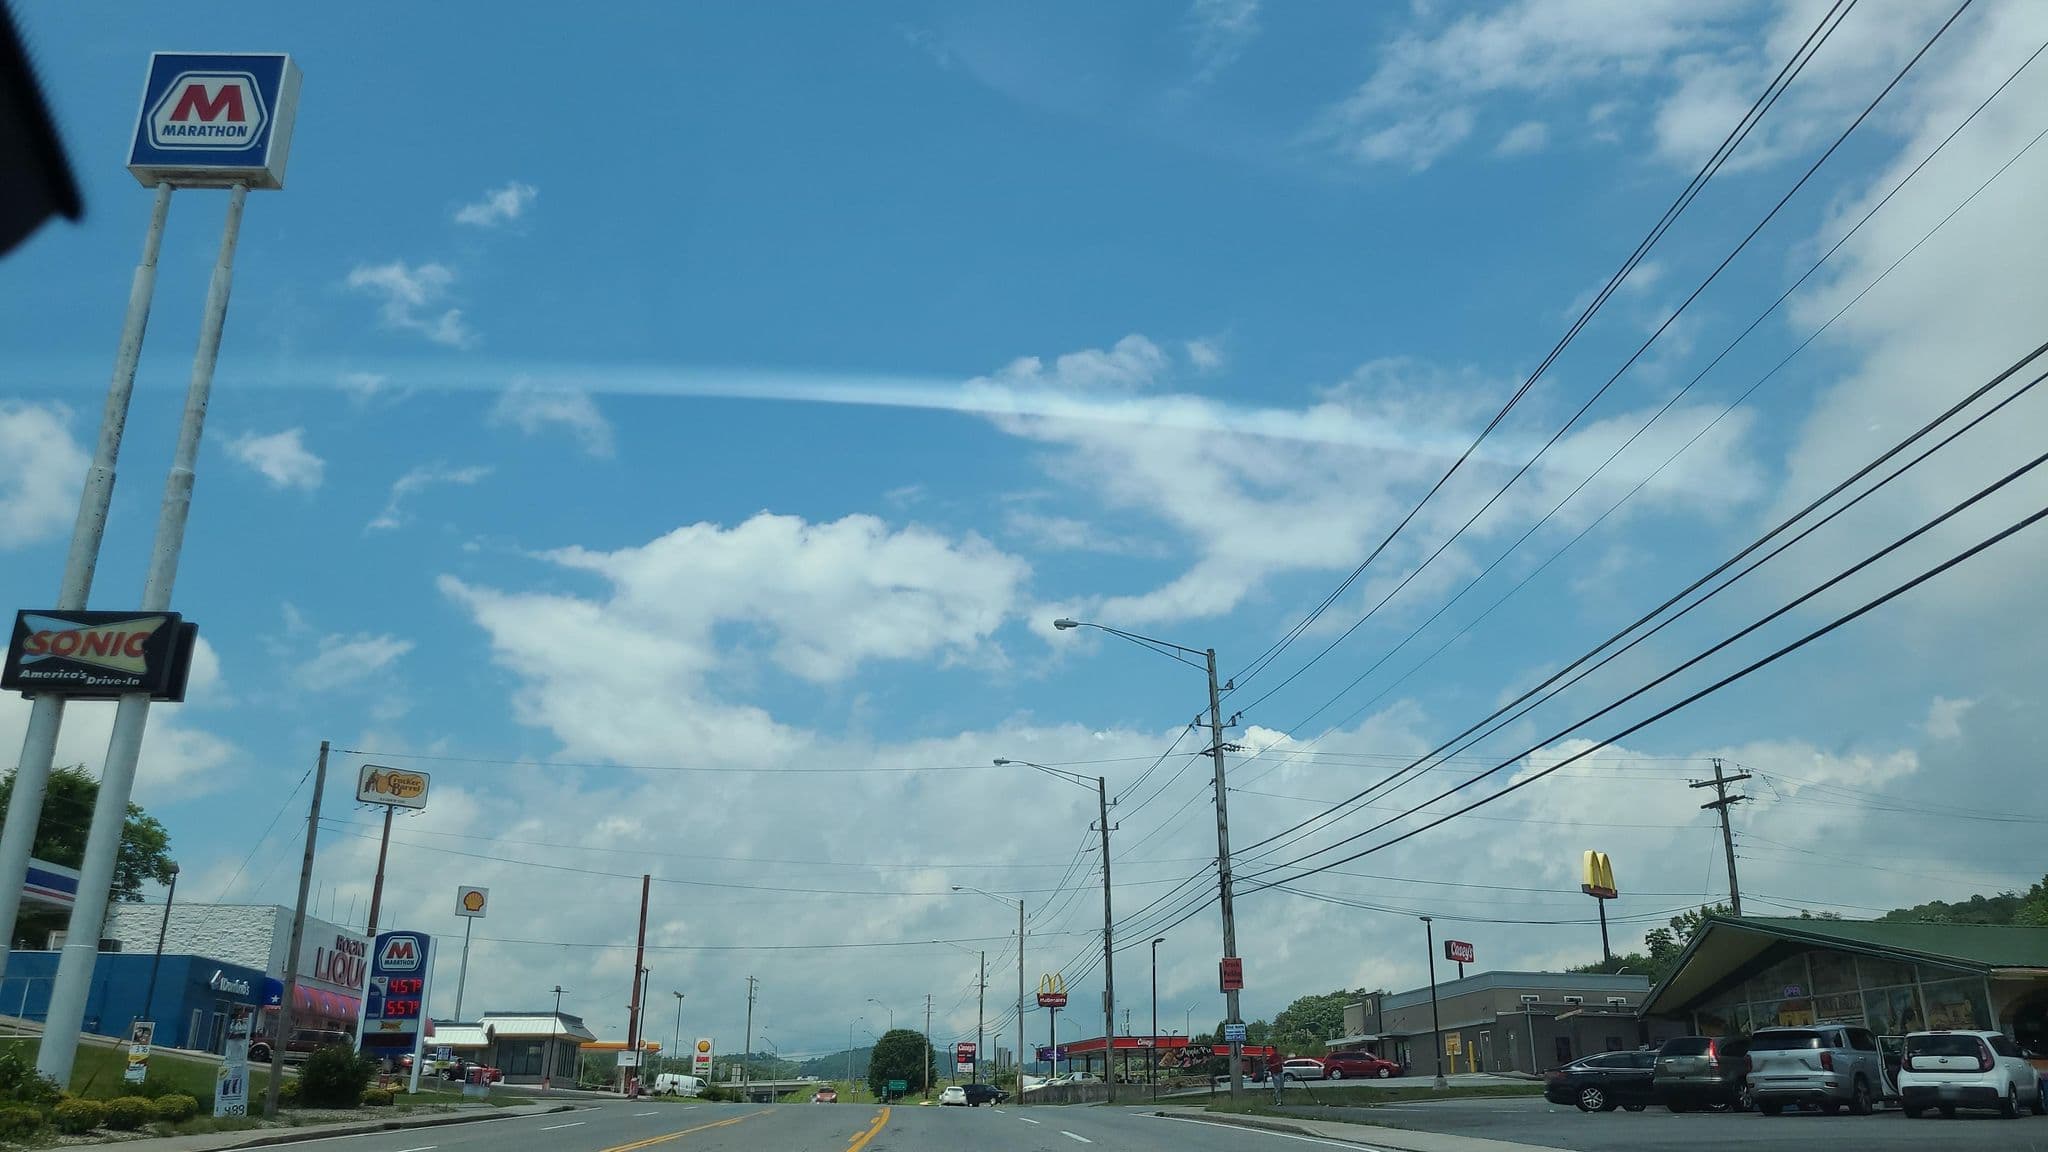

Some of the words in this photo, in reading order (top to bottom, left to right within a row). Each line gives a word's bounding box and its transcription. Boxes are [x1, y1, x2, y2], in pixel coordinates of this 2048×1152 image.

[168, 85, 246, 122] M
[161, 125, 248, 137] MARATHON
[24, 630, 152, 657] SONIC
[19, 669, 88, 679] America's
[86, 675, 140, 686] Drive-In
[1450, 942, 1473, 960] Casey's
